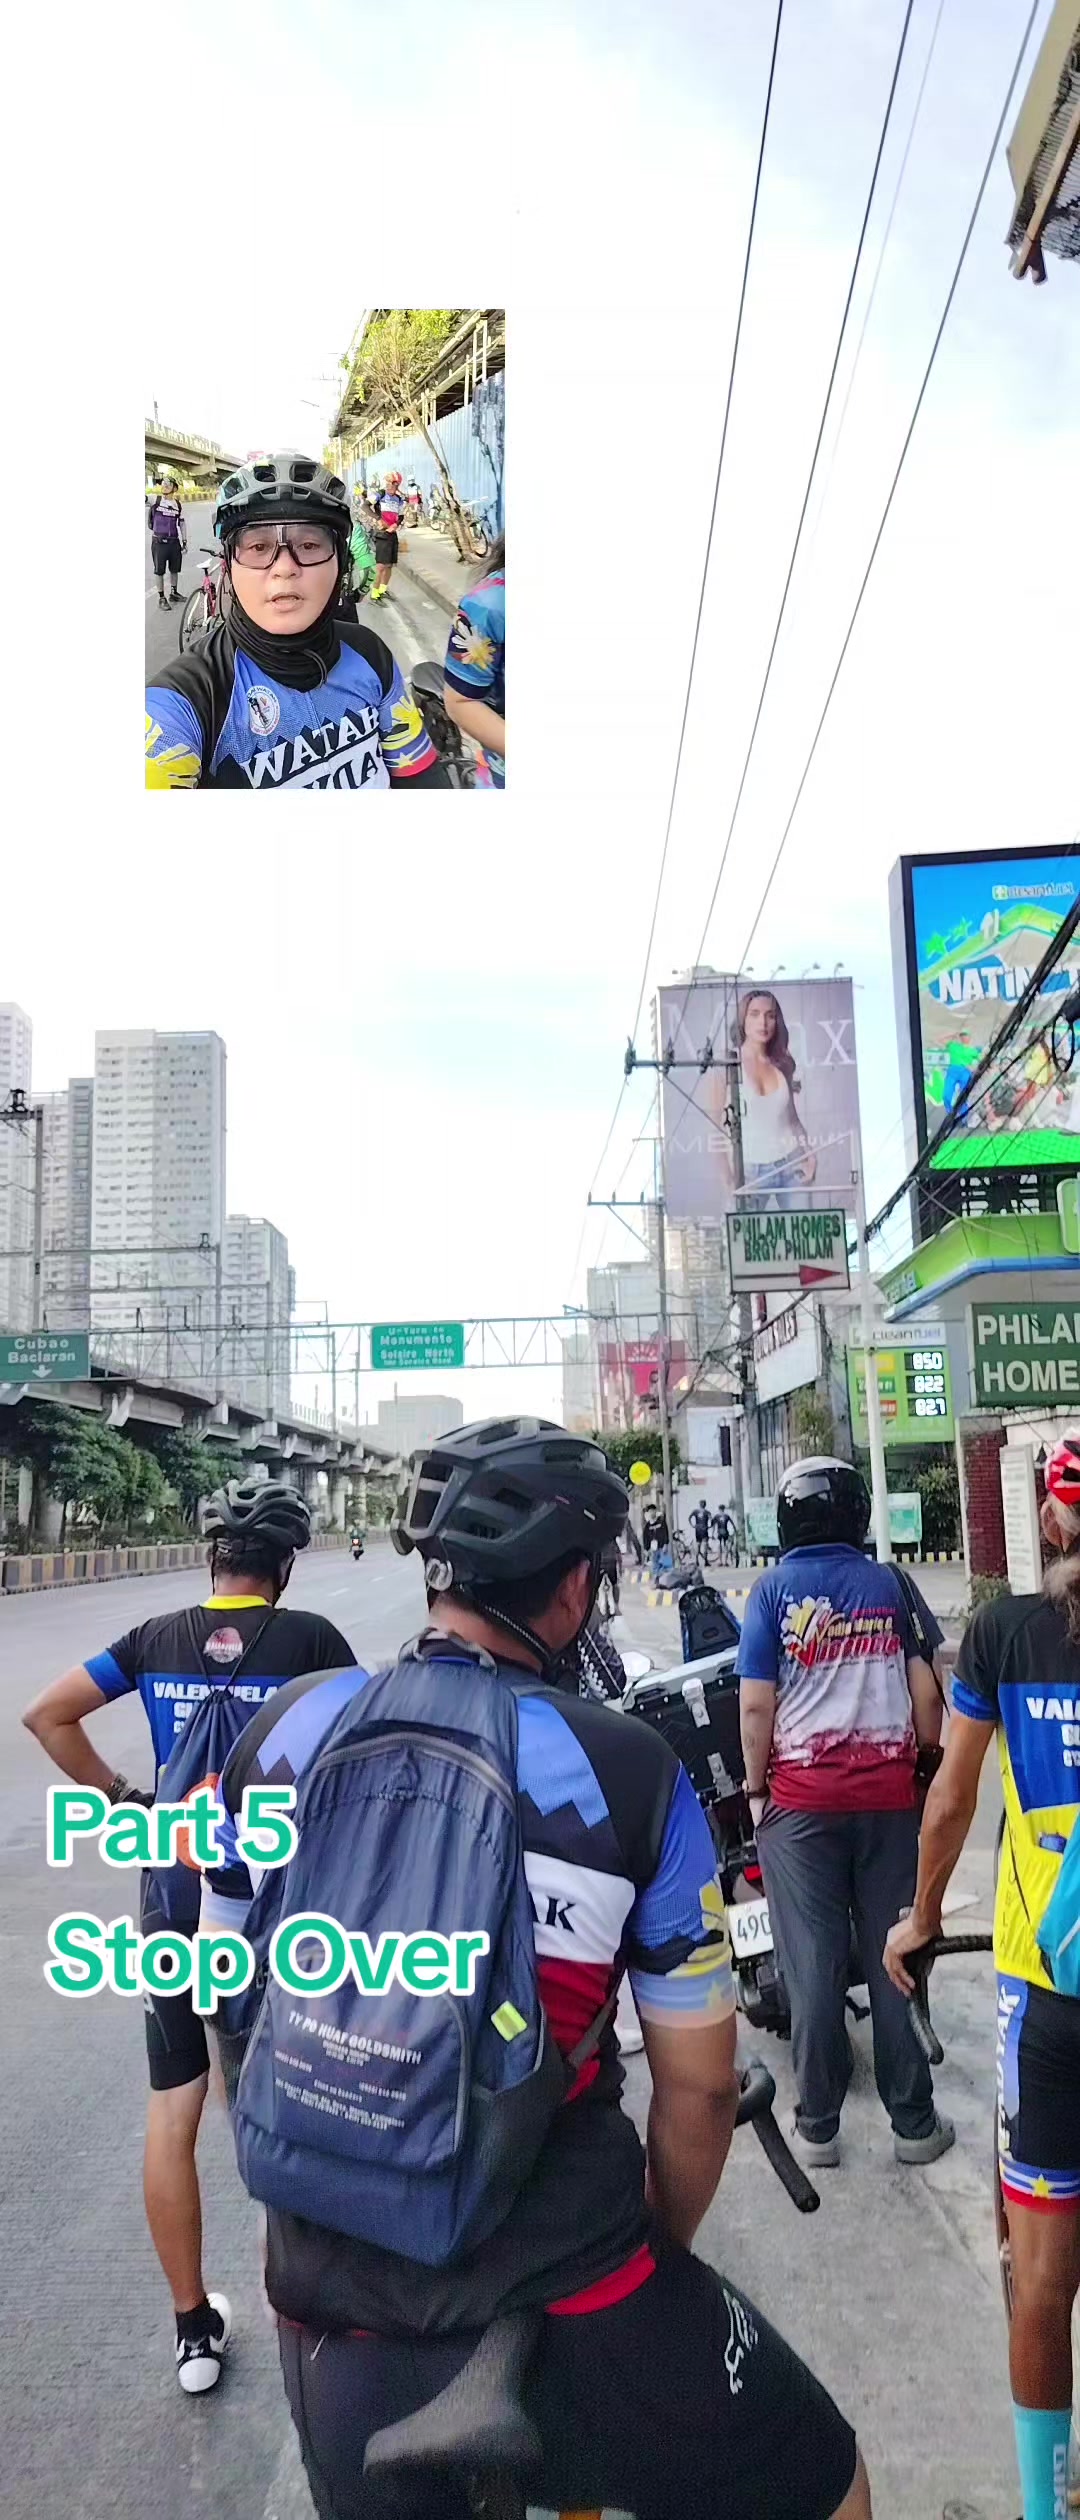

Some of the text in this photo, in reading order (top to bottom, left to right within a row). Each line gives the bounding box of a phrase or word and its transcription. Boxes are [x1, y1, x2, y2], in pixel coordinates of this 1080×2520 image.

[733, 1214, 841, 1242] PHILAM HOMES
[744, 1237, 833, 1262] BRGY. PHILAM
[14, 1338, 69, 1350] Cubao
[380, 1334, 453, 1345] Monumento
[8, 1350, 76, 1364] Baclaran
[348, 2034, 422, 2065] GOLDSMITH
